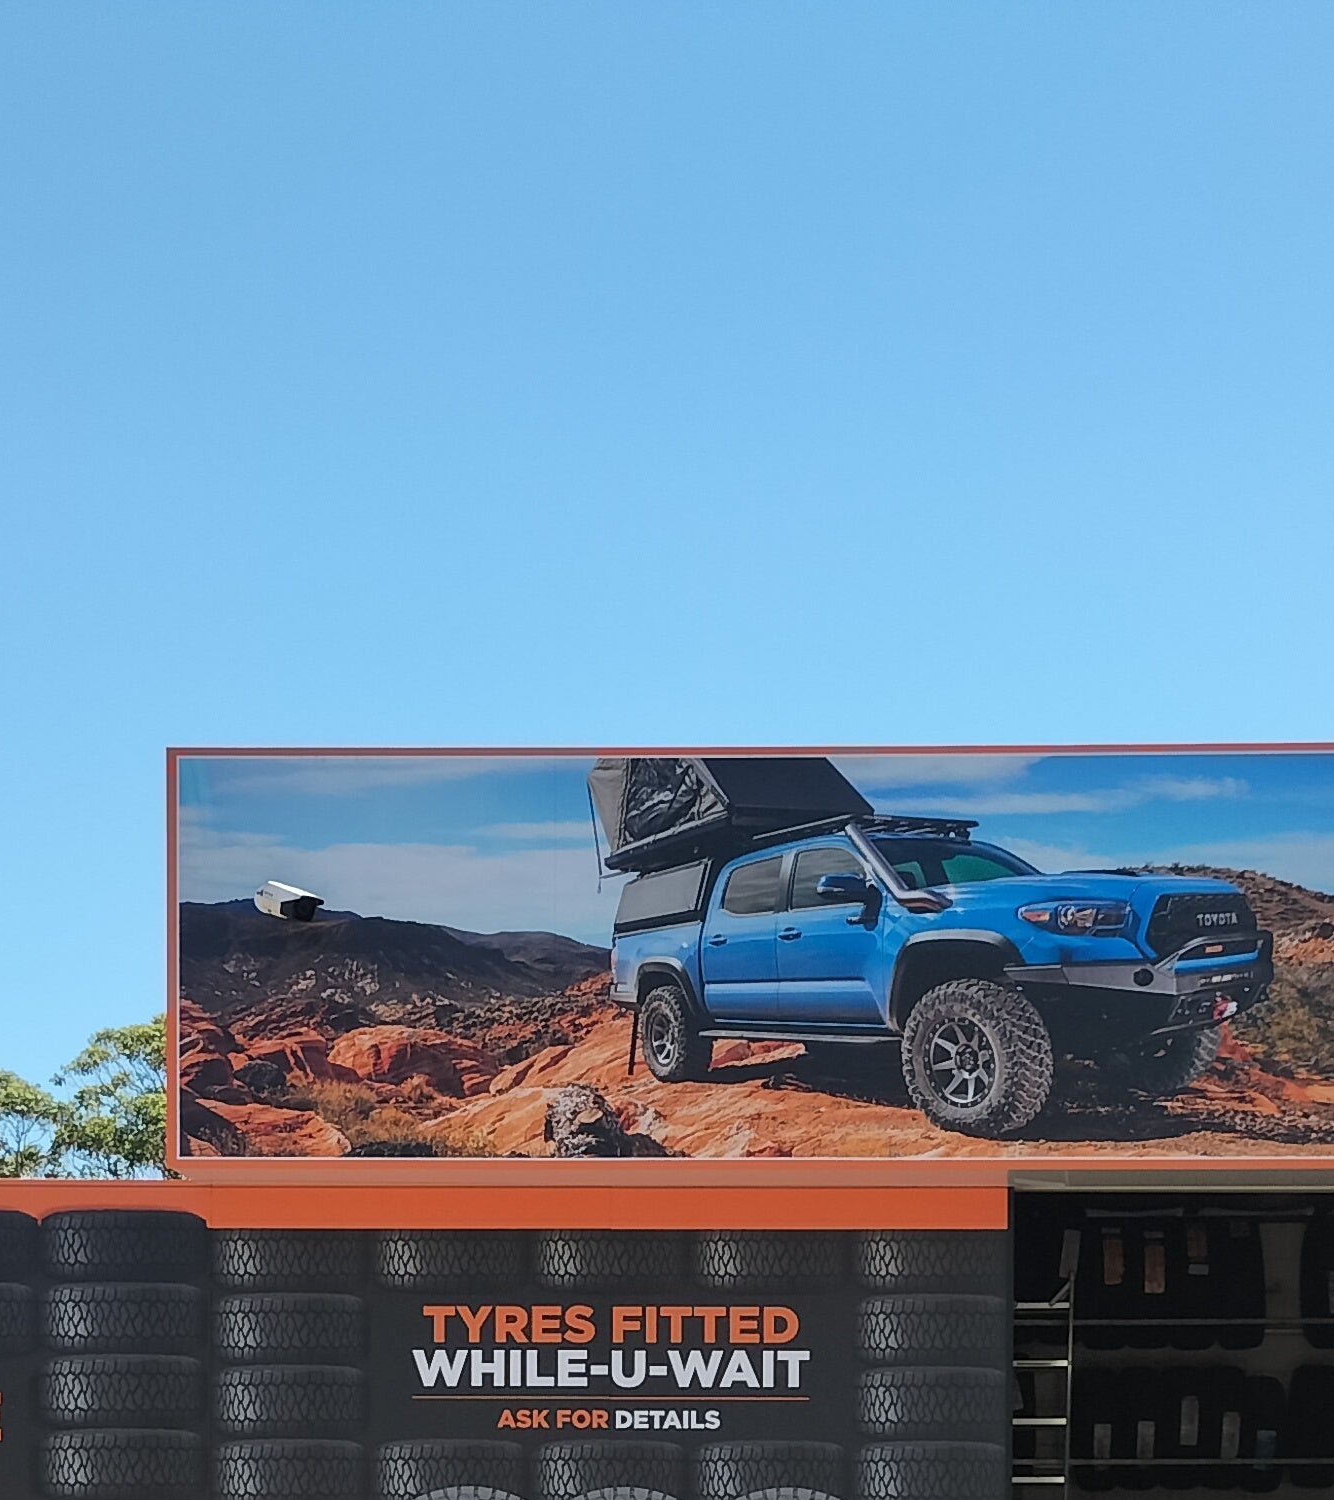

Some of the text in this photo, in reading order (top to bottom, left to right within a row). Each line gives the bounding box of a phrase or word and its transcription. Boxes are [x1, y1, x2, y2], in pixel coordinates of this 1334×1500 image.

[1196, 911, 1238, 927] TOYOTA
[423, 1306, 800, 1344] TYRES FITTED
[412, 1350, 810, 1389] WHILE-U-WAIT
[497, 1410, 721, 1430] ASK FOR DETAILS
